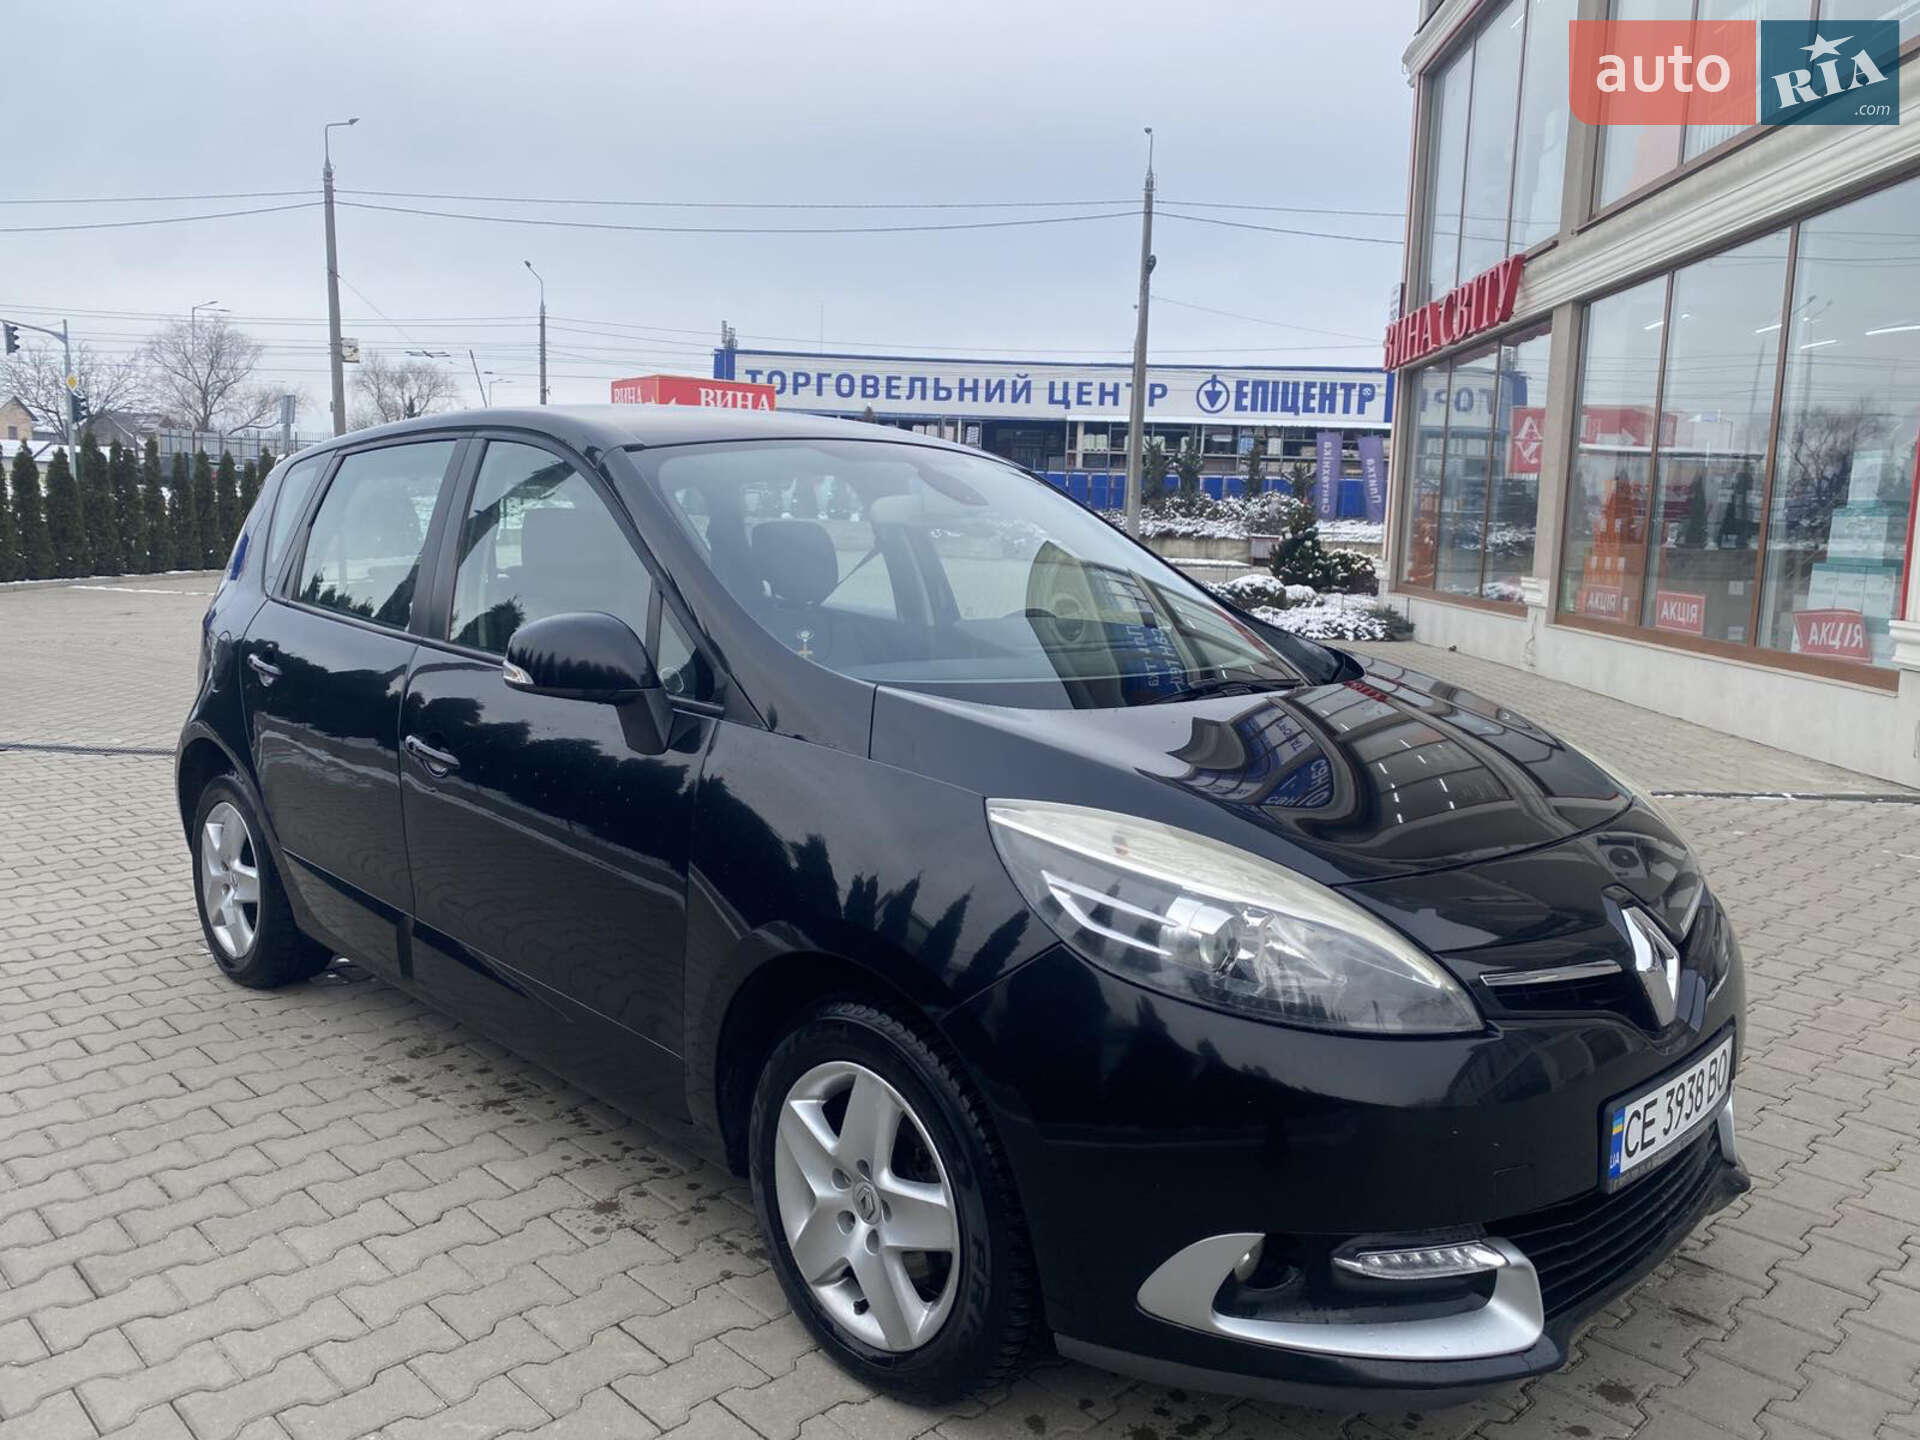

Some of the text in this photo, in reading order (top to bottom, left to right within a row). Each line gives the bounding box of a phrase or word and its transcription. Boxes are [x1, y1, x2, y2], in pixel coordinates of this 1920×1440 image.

[1383, 302, 1441, 372] ВИНА
[1439, 254, 1526, 347] СВІТУ
[698, 387, 772, 413] ВИНА
[745, 368, 1168, 409] ТОРГОВЕЛЬНИЙ ЦЕНР
[1234, 380, 1376, 416] ЕПІЦЕНТР
[1587, 591, 1617, 613] АКЦІЯ
[1661, 600, 1698, 624] АКЦІЯ
[1807, 621, 1864, 650] АКЦІЯ
[1624, 1049, 1728, 1158] CE 3938 BO
